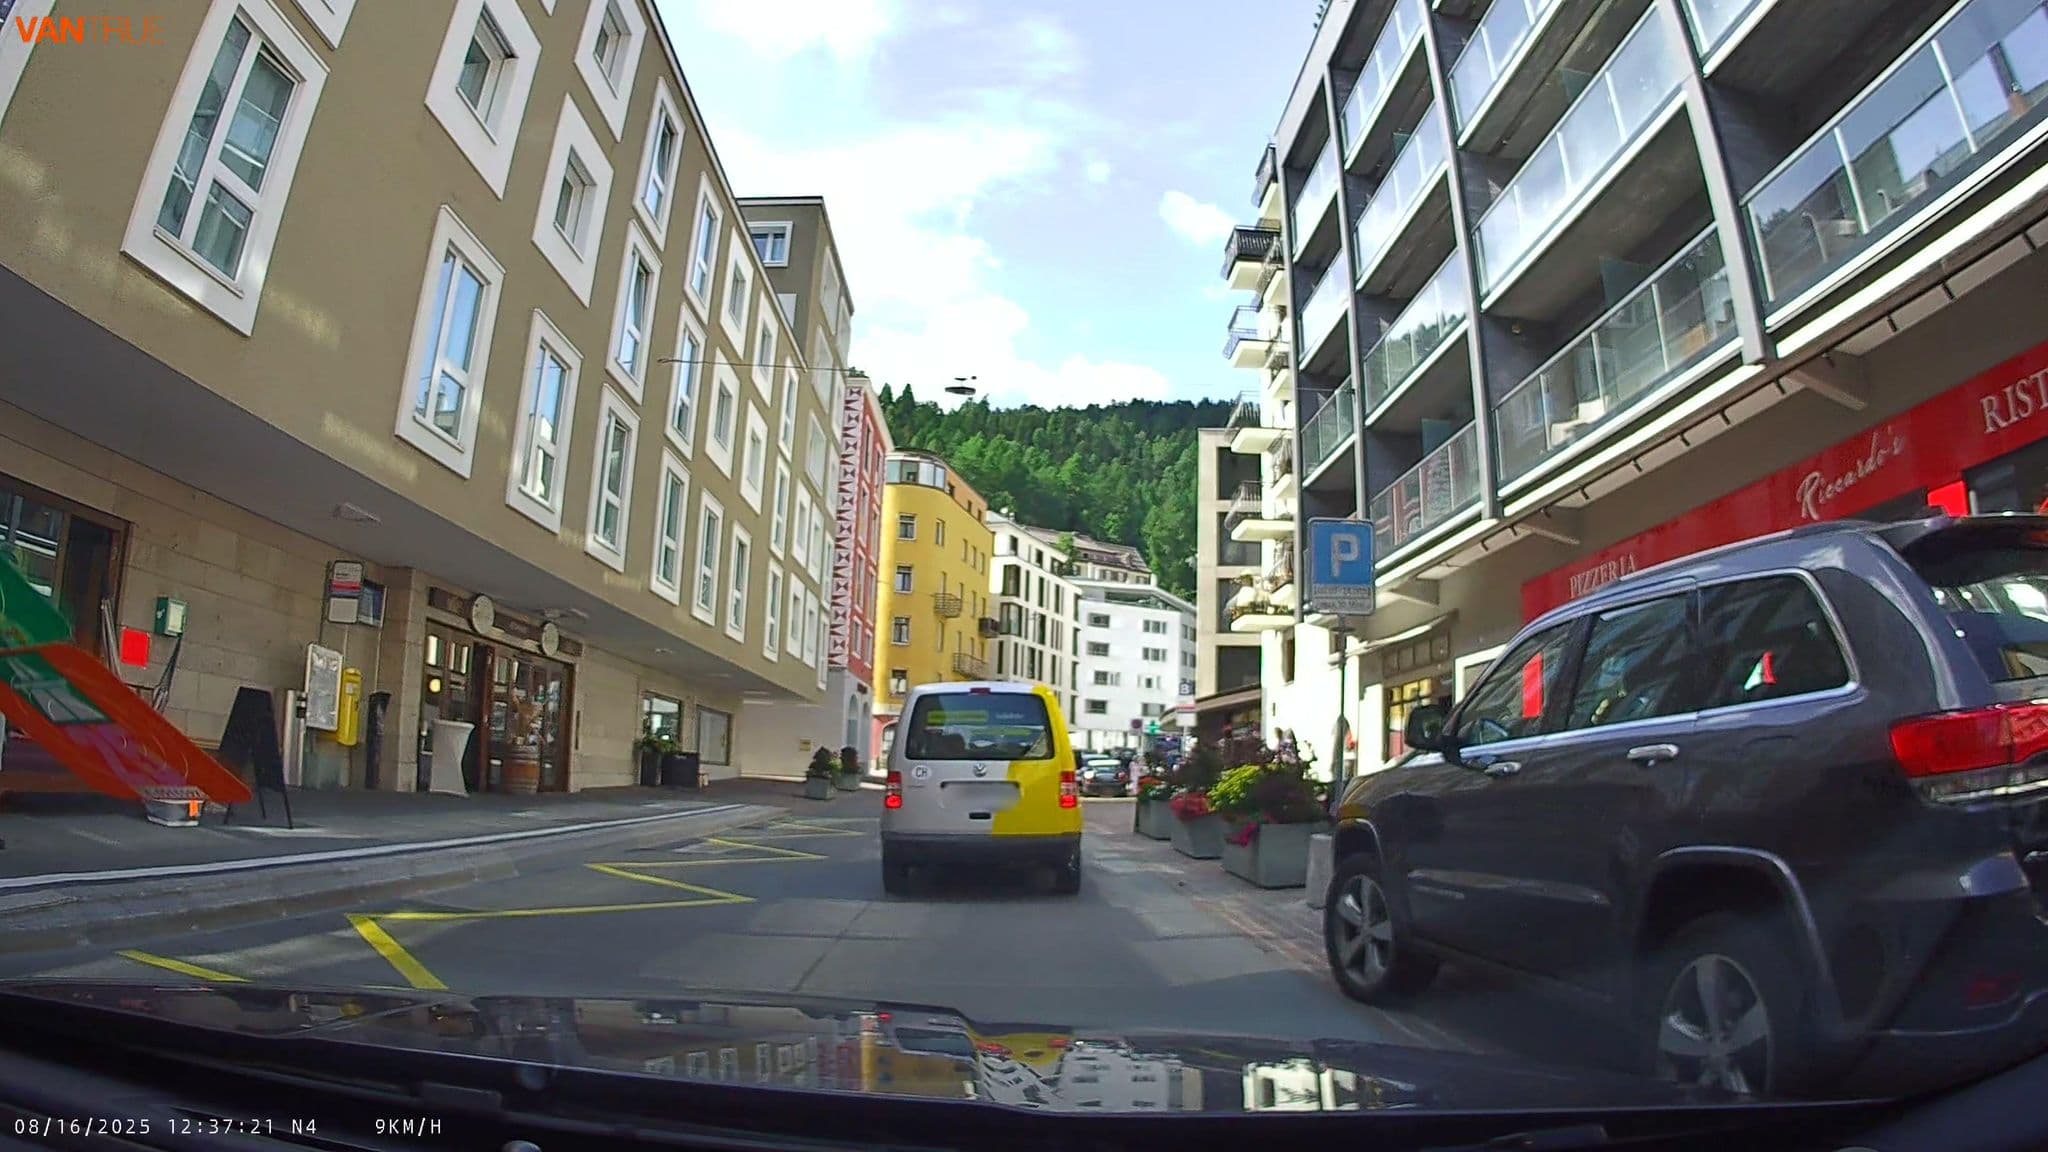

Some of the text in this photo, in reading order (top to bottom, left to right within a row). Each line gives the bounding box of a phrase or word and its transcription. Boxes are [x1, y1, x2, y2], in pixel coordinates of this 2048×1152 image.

[1569, 552, 1636, 600] PIZZERIA
[1796, 425, 1905, 520] Riccardo's
[1331, 533, 1359, 577] P
[915, 767, 928, 778] CH
